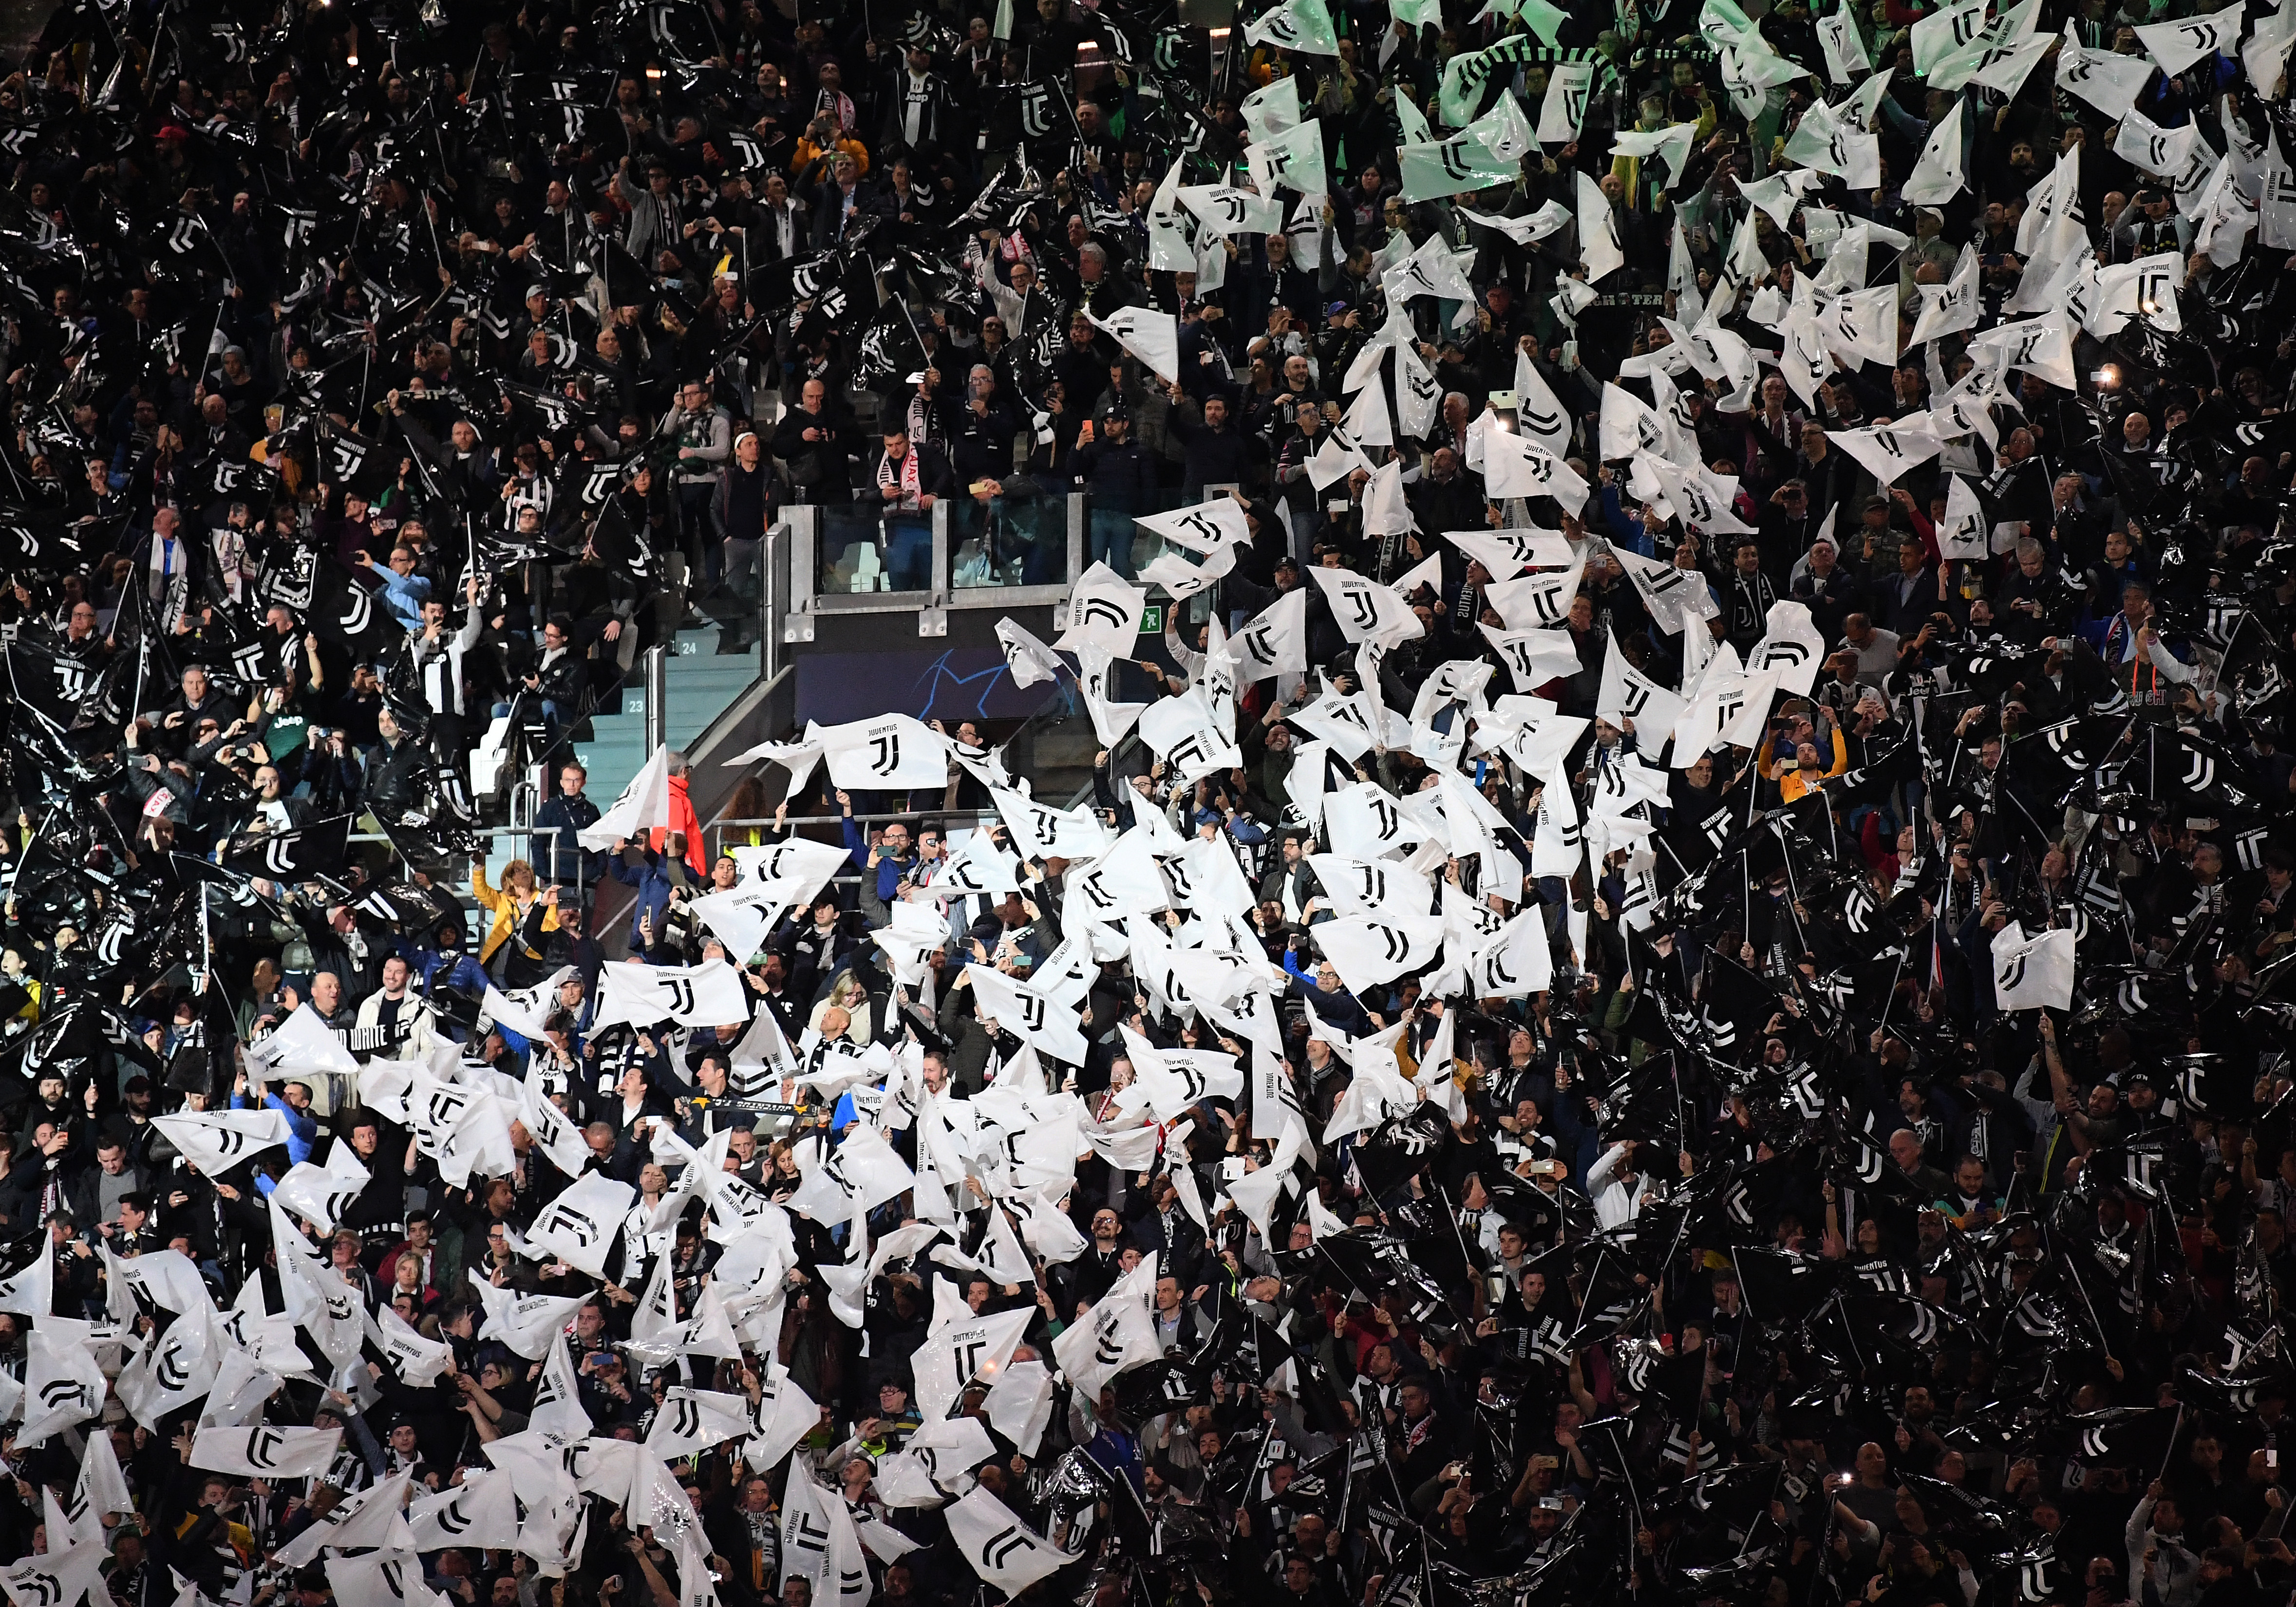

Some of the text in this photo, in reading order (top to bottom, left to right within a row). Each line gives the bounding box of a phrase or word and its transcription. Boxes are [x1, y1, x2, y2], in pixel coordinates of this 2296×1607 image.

[1998, 20, 2015, 47] JUVENTUS
[905, 93, 928, 103] Jeep
[1209, 187, 1235, 198] JUVENTUS
[939, 264, 962, 280] JUVENTUS
[1641, 412, 1663, 436] JUVENTUS
[337, 437, 366, 455] JUVENTUS
[908, 455, 918, 482] AJAX
[1993, 474, 2016, 499] JUVENTUS
[1073, 598, 1082, 626] JUVENTUS
[683, 642, 696, 654] 24
[56, 657, 84, 670] JUVENTUS
[1908, 687, 1928, 696] Jee
[629, 701, 643, 713] 23
[274, 715, 303, 729] Jeep
[868, 724, 897, 737] JUVENTUS
[1365, 788, 1378, 800] JUVE
[1540, 793, 1549, 825] JUVENTUS
[1644, 868, 1657, 899] JUVENTUS
[732, 894, 760, 906] JUVENTUS
[1051, 937, 1073, 965] JUVENTUS
[1773, 942, 1784, 976] JUVENTUS
[1015, 983, 1044, 998] JUVENTUS
[351, 1025, 388, 1051] WHITE
[772, 1052, 785, 1075] JUVENT
[683, 1163, 695, 1195] JUVENTUS
[1372, 1238, 1404, 1249] JUVENTUS
[1854, 1260, 1887, 1272] JUVENTUS
[391, 1339, 422, 1359] JUVENTUS
[1259, 1457, 1273, 1469] Je
